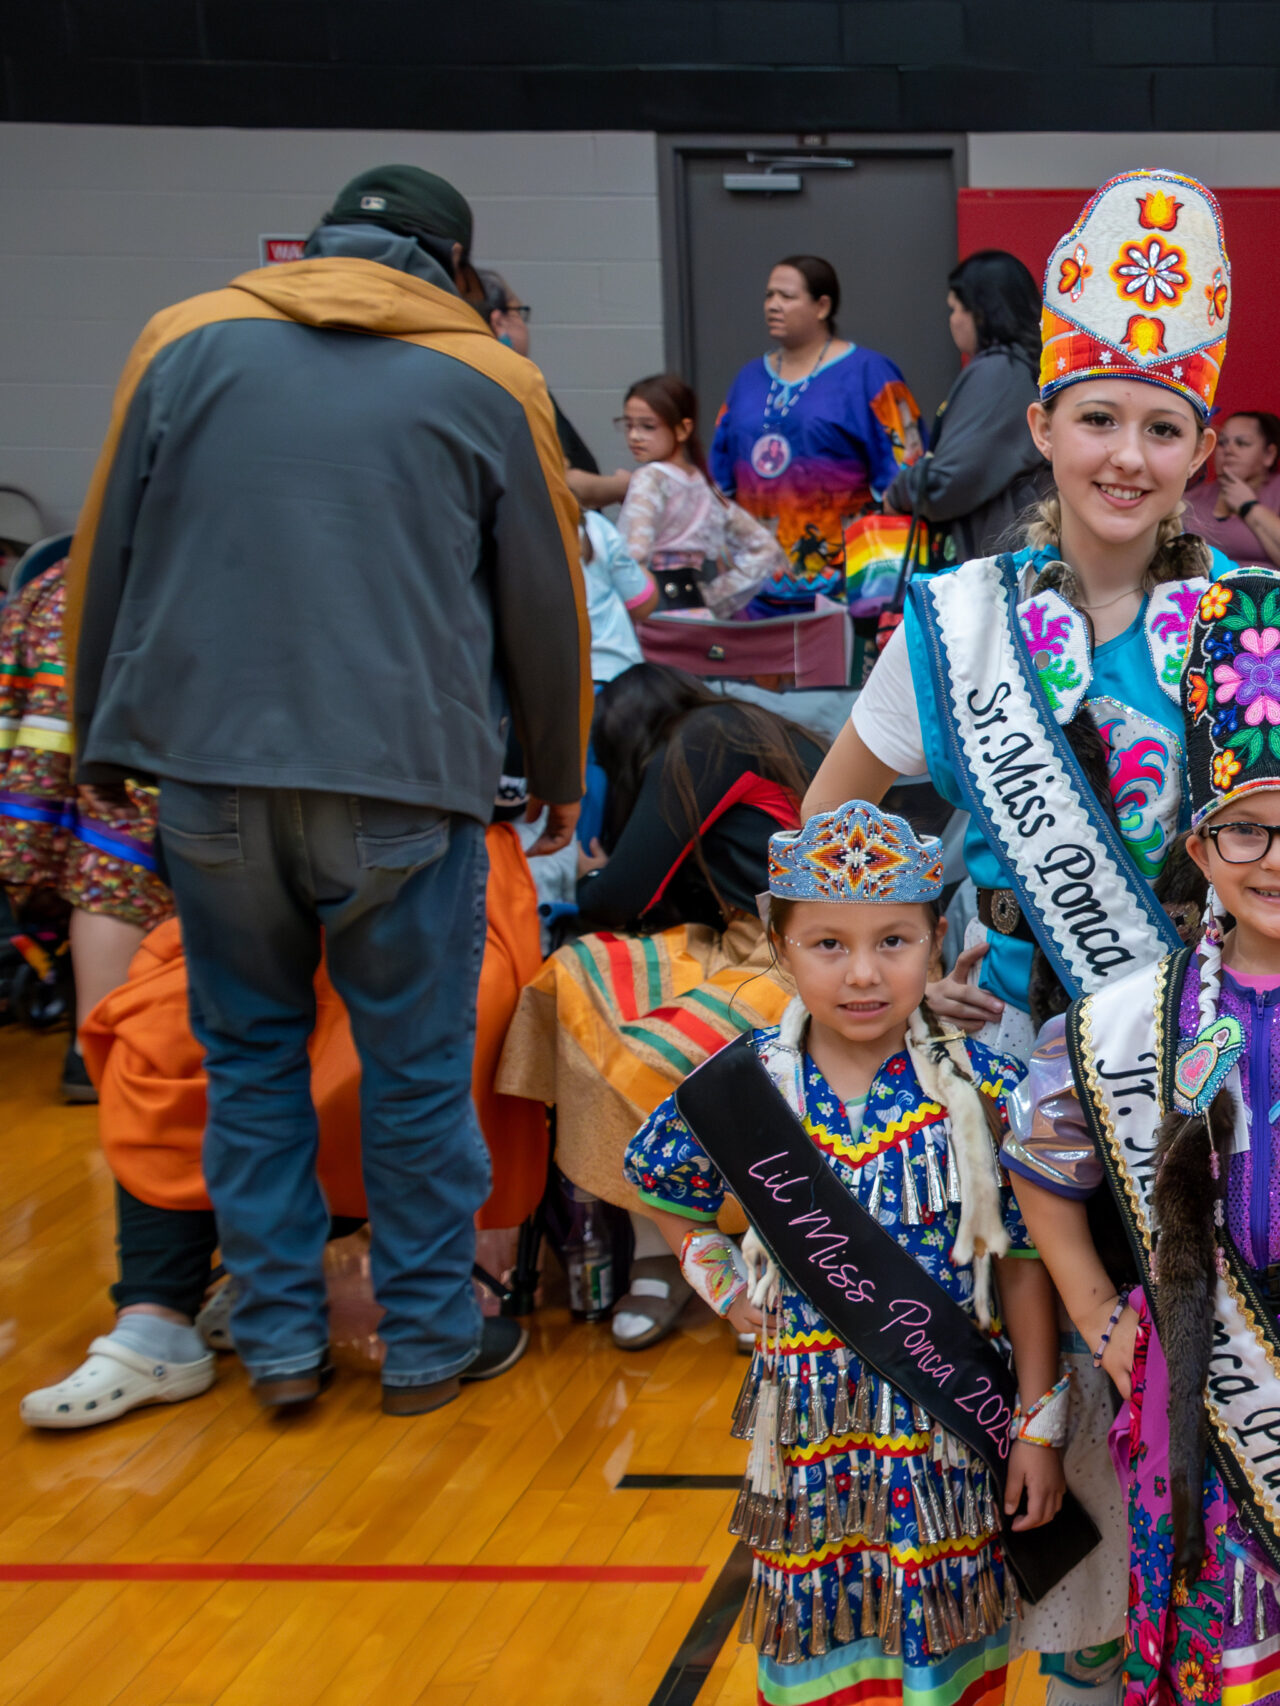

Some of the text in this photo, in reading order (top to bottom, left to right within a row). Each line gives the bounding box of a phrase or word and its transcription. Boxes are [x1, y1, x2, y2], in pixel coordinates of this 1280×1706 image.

[1033, 843, 1137, 977] Ponca
[748, 1151, 809, 1203] Lil
[788, 1208, 876, 1303] Miss
[879, 1299, 957, 1388] Ponca
[1207, 1319, 1260, 1406] nca
